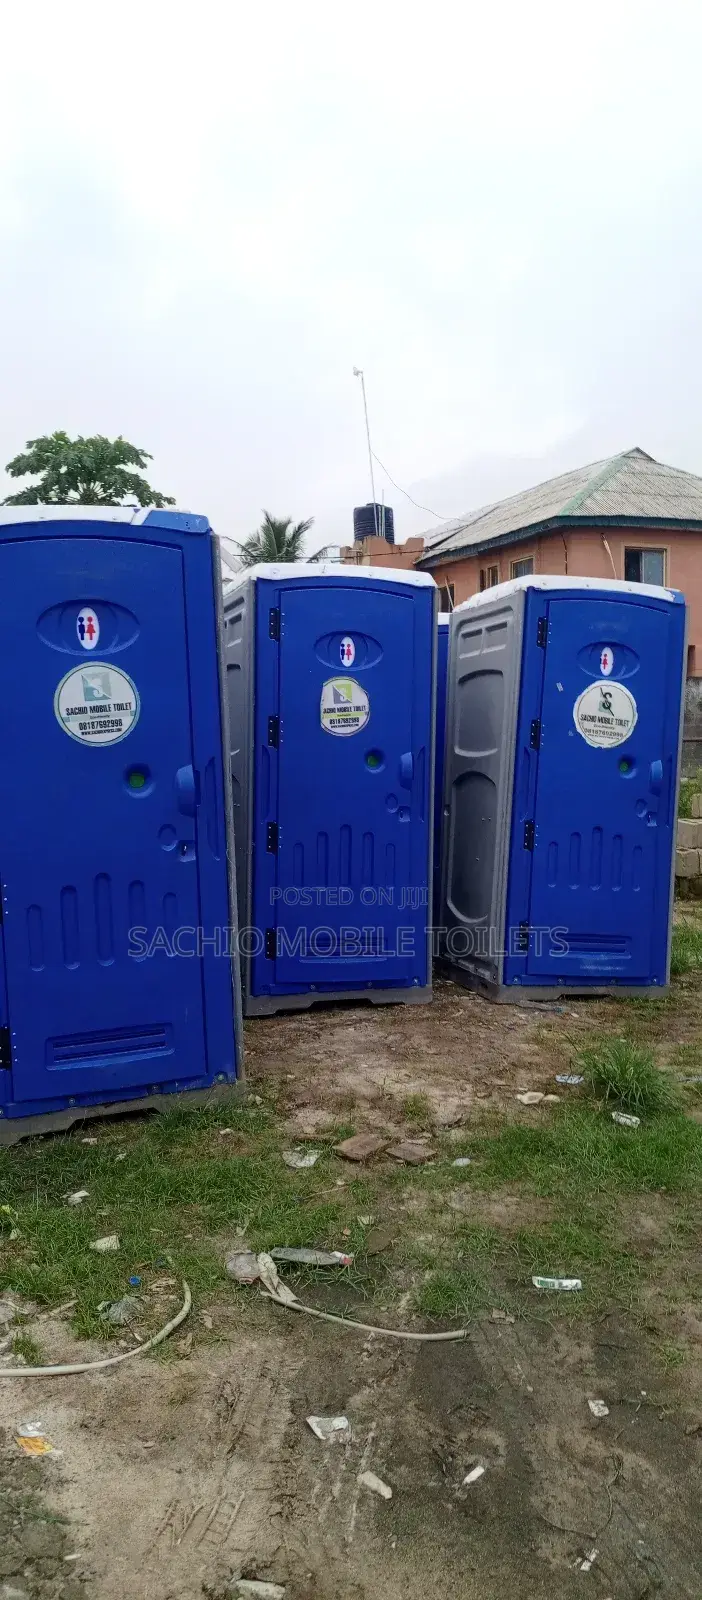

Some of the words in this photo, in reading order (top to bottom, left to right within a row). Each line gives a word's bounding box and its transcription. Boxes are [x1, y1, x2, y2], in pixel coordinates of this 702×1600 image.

[65, 706, 88, 716] SACHIO
[90, 703, 112, 714] MOBILE
[113, 702, 132, 712] TOILET
[78, 718, 123, 731] 08187692998
[597, 715, 614, 726] MOBILE
[614, 718, 631, 728] TOILET
